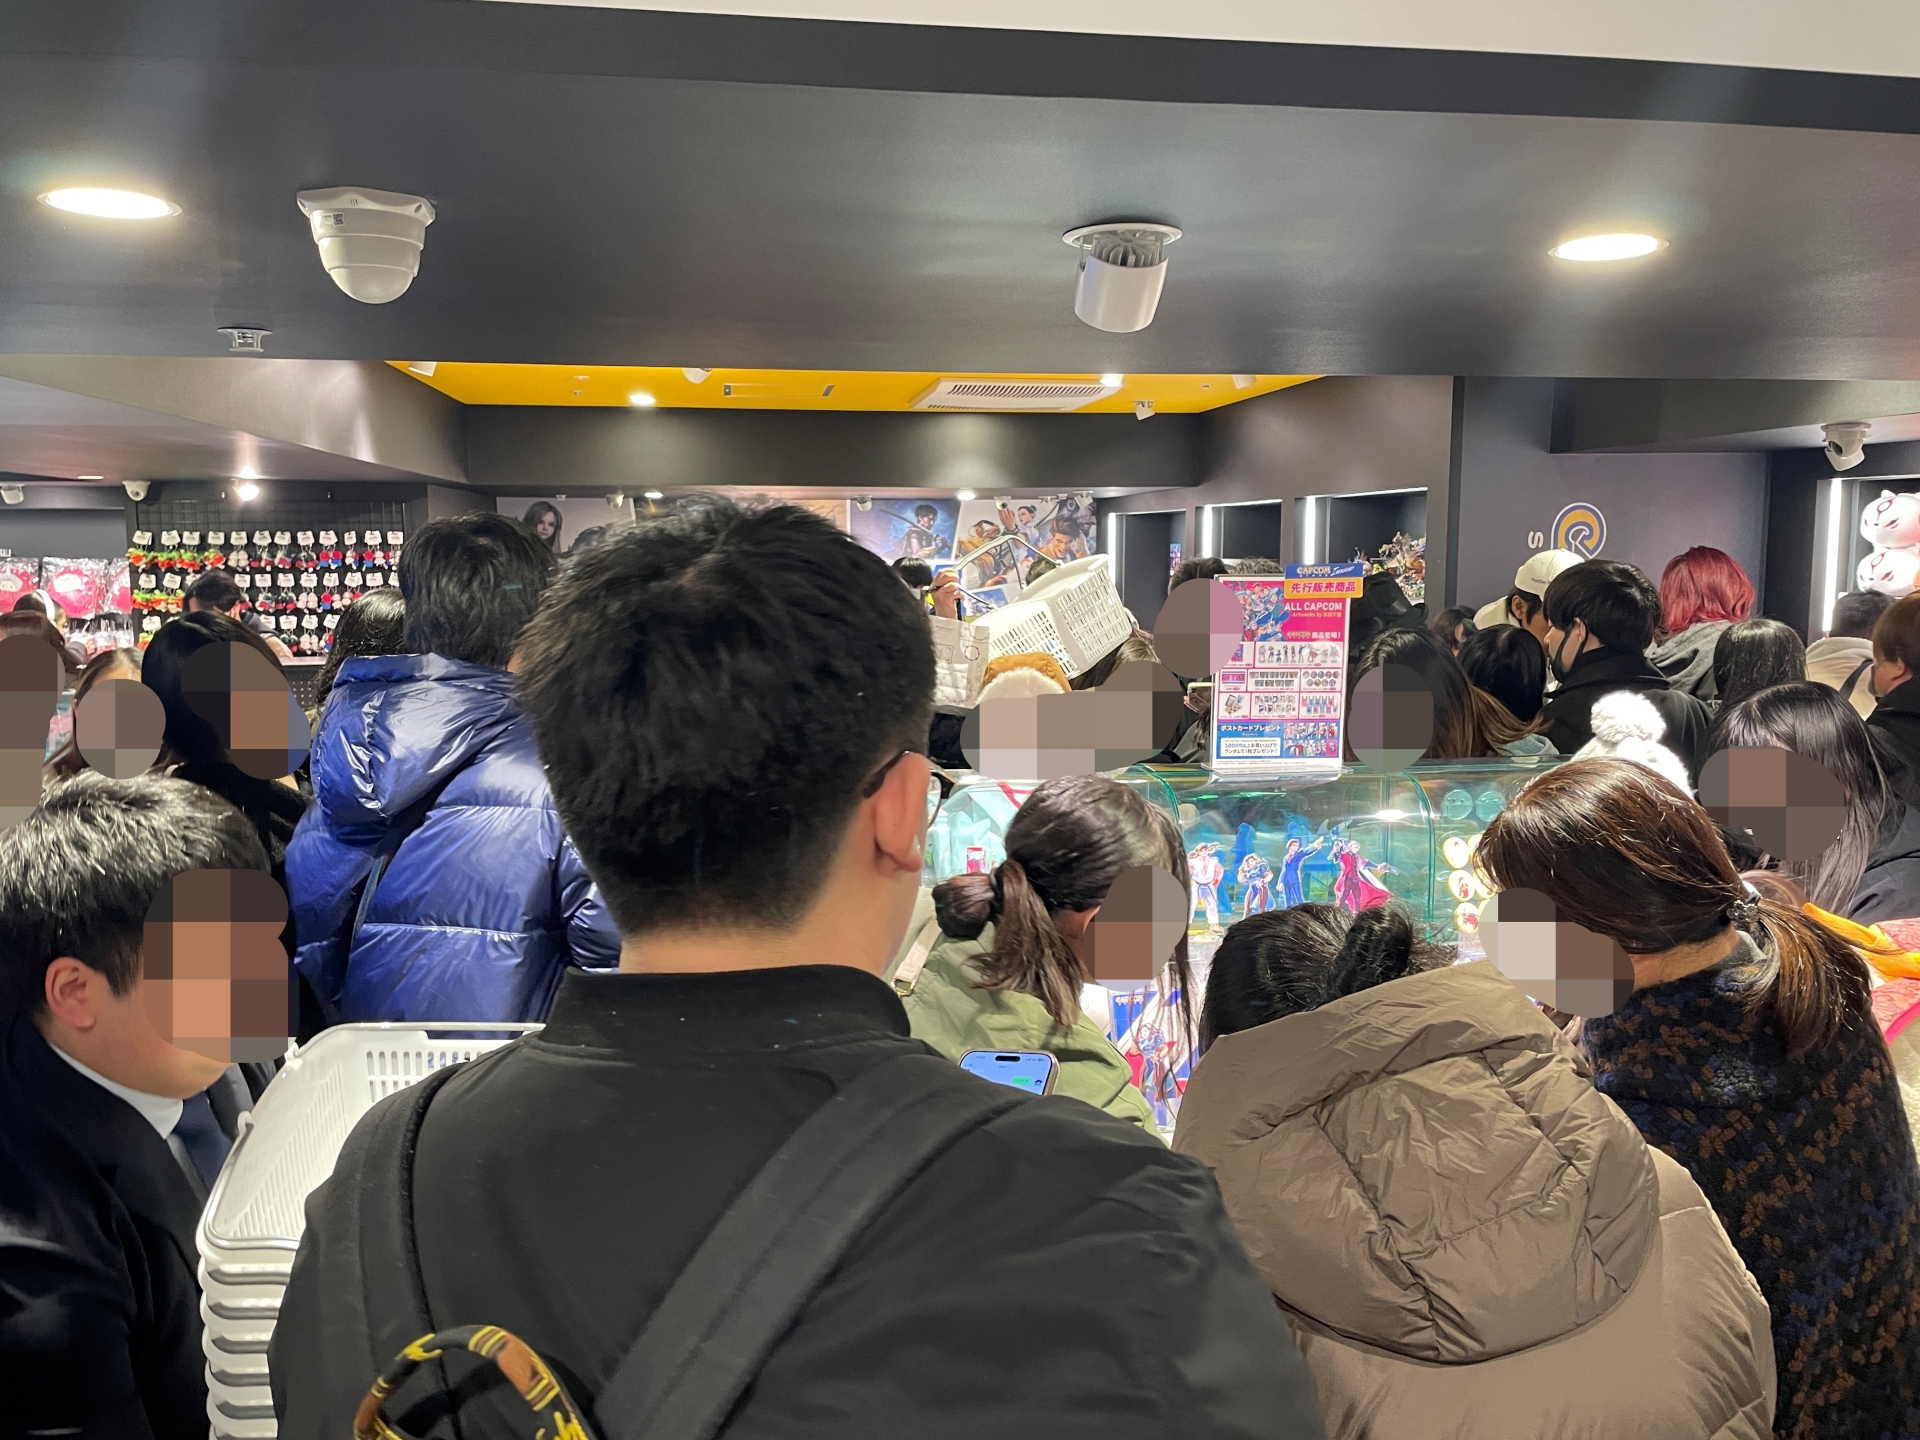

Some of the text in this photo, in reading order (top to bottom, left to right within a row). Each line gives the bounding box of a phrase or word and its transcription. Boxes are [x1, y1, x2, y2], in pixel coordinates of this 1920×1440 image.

[1296, 566, 1330, 574] CAPCOM
[1291, 582, 1356, 593] 先行販売商品
[1284, 602, 1342, 611] ALL CAPCOM
